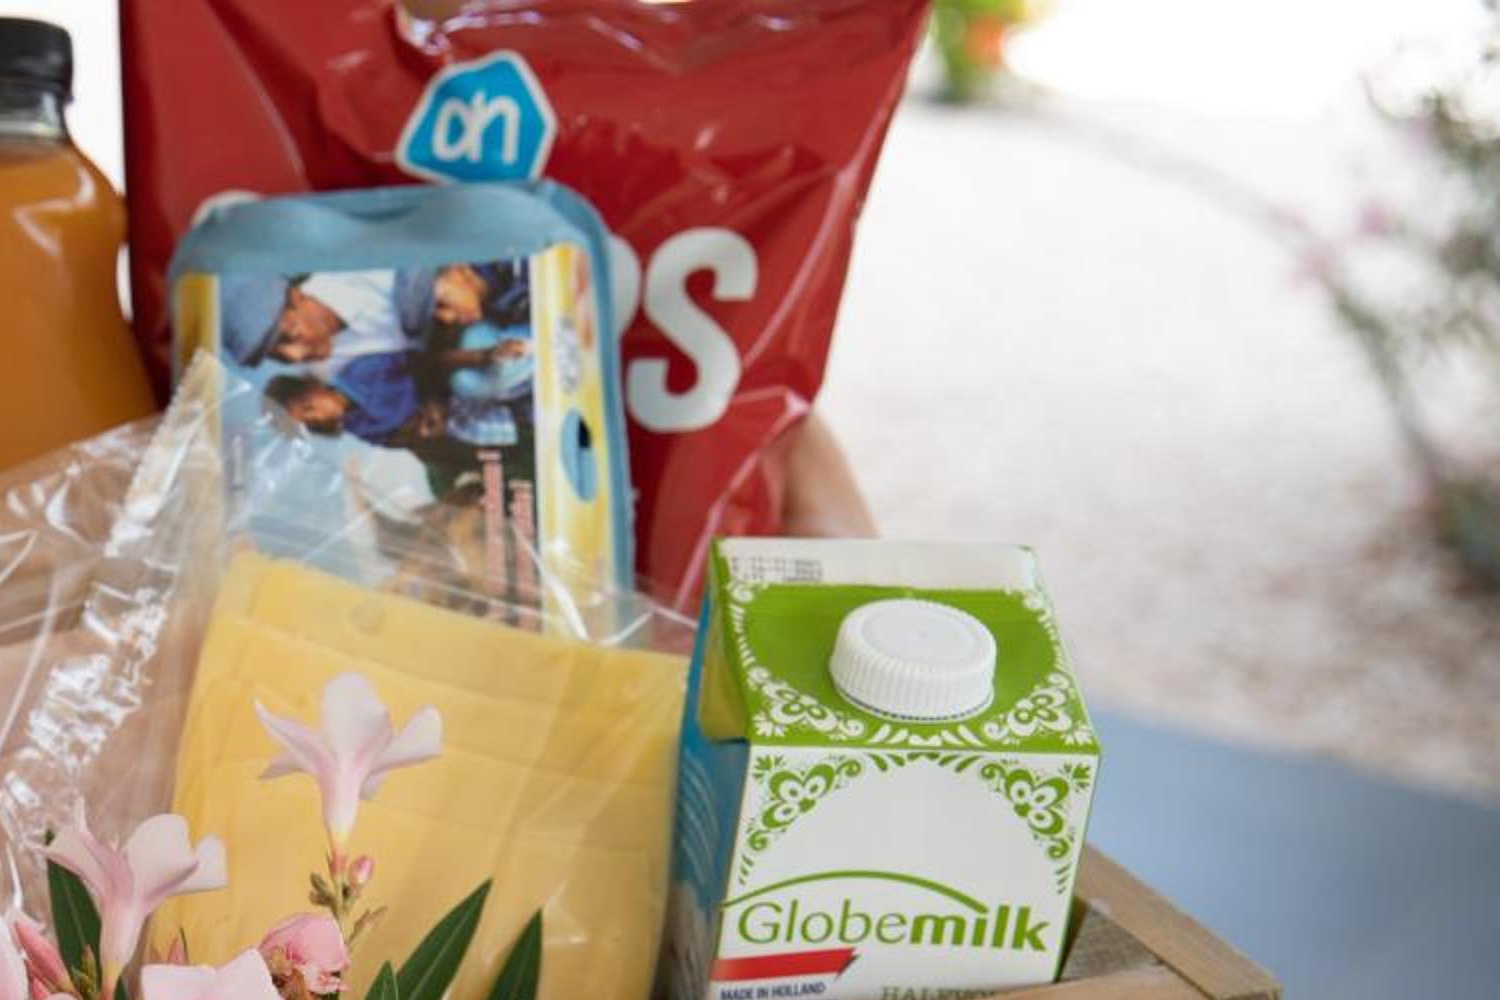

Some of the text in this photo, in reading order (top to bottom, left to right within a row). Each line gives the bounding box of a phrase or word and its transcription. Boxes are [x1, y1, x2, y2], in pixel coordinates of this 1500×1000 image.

[738, 898, 1049, 951] Globemilk
[756, 986, 770, 999] IN
[772, 981, 826, 997] HOLLAND
